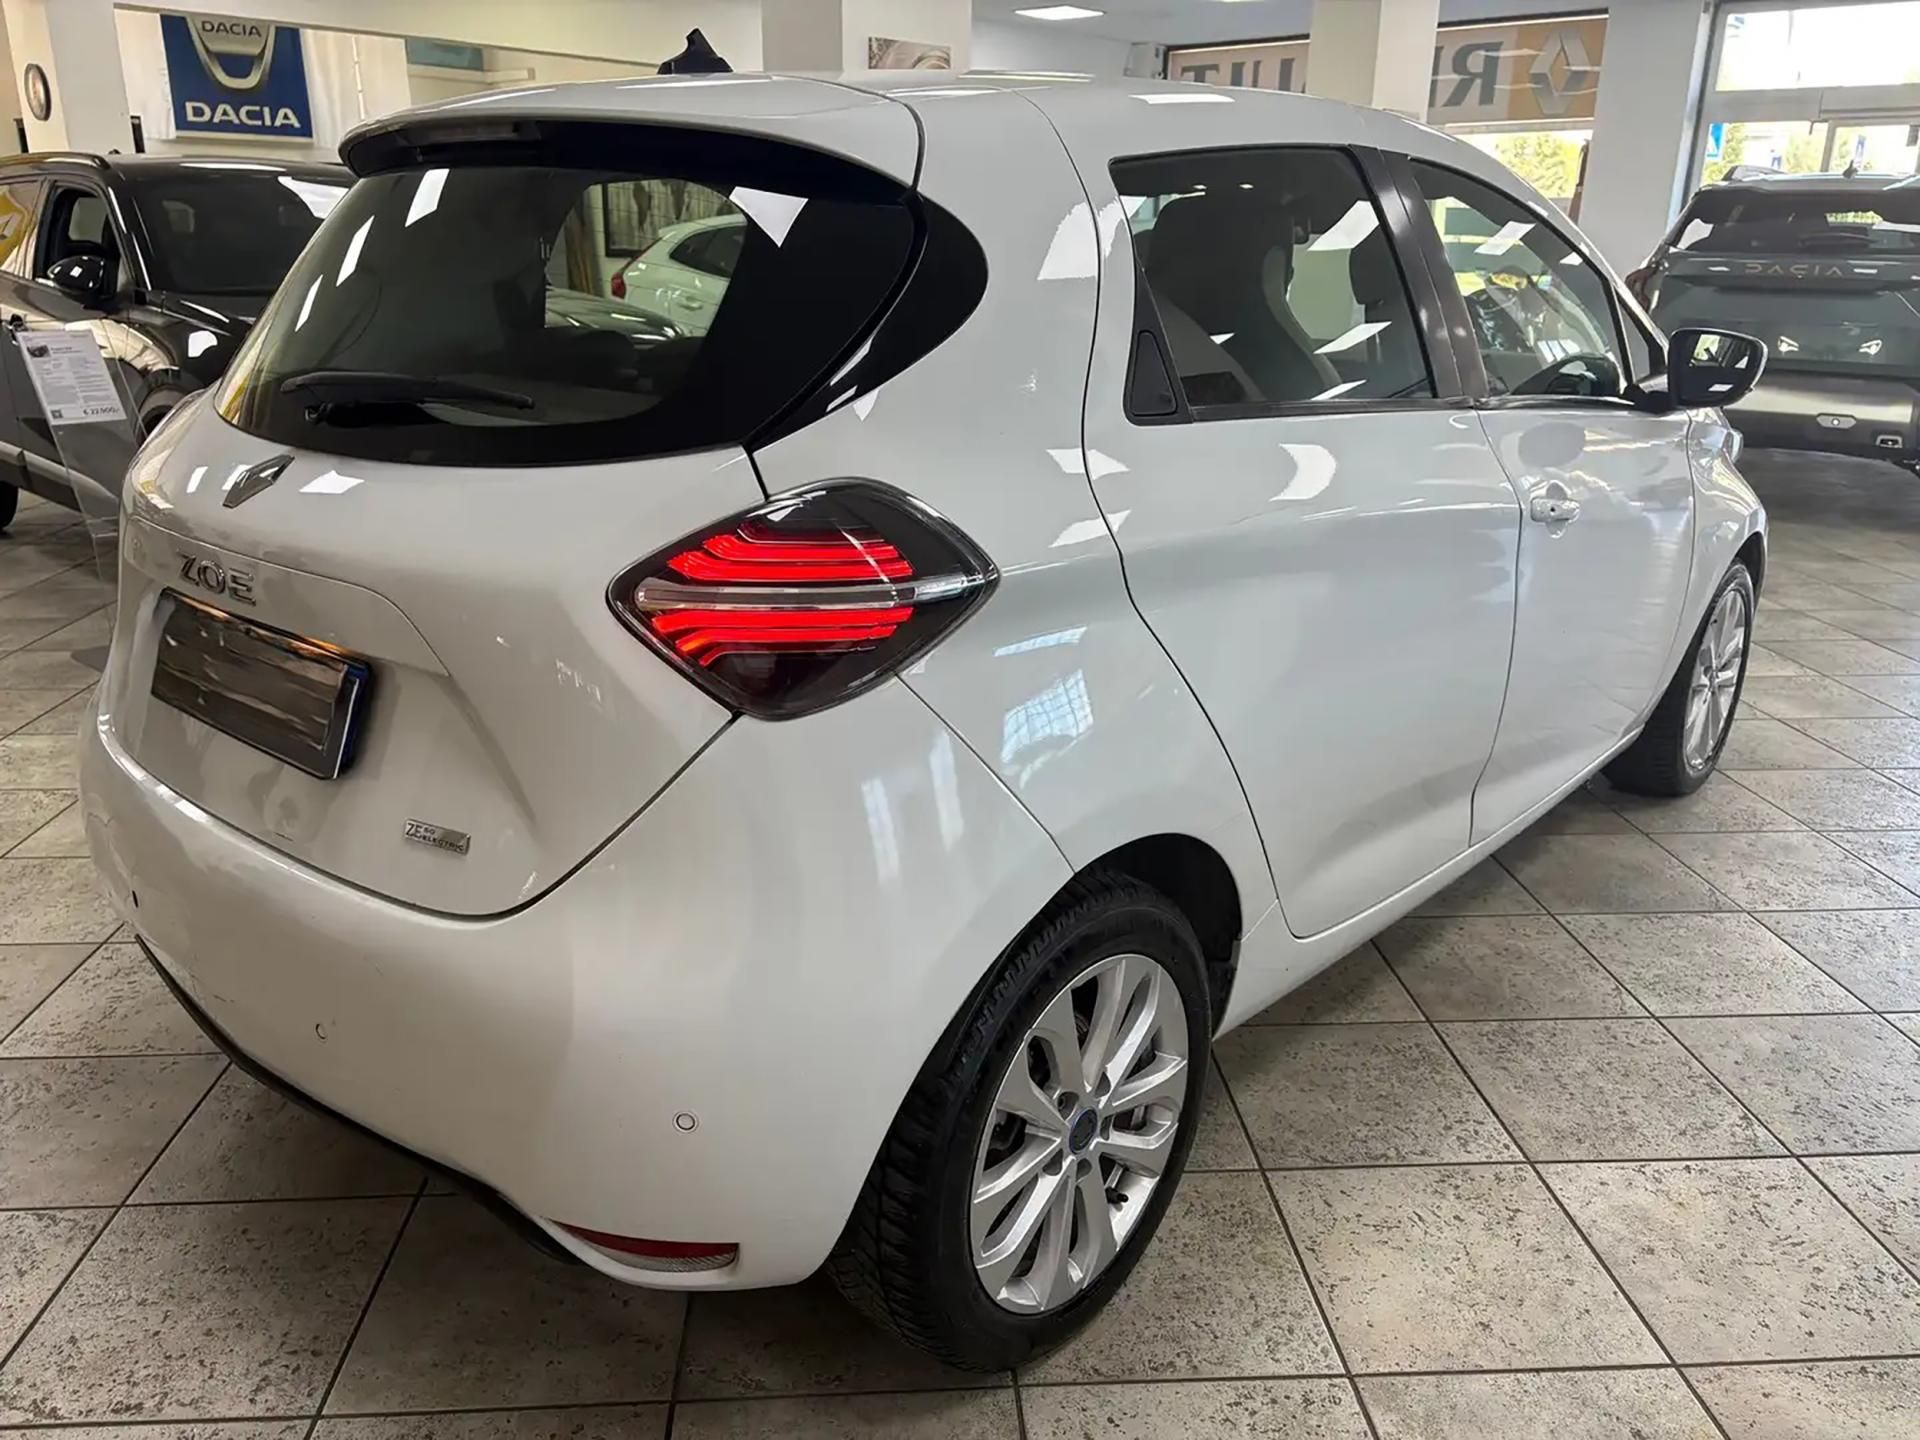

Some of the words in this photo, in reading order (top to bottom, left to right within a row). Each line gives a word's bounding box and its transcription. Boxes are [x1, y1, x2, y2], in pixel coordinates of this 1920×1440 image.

[201, 20, 262, 38] DACIA
[185, 102, 301, 128] DACIA
[1744, 263, 1843, 277] DACIA
[177, 553, 257, 607] ZOE
